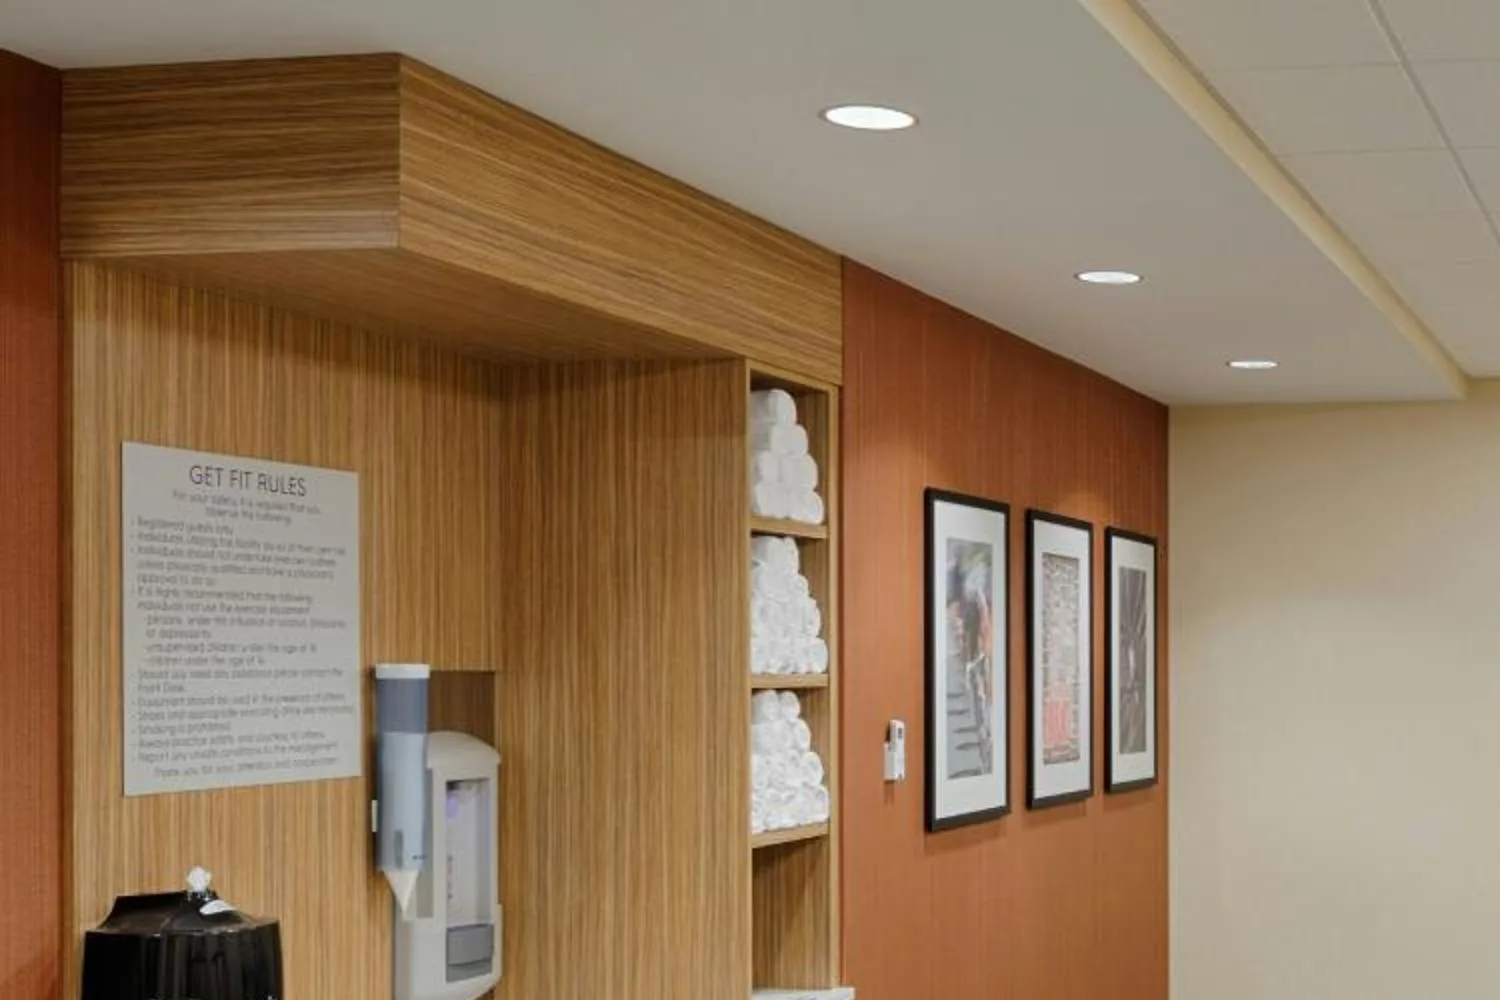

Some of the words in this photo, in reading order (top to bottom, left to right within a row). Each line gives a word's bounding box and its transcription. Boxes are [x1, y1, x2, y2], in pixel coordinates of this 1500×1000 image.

[189, 465, 224, 487] GET
[229, 469, 252, 491] FIT
[257, 473, 307, 497] RULES
